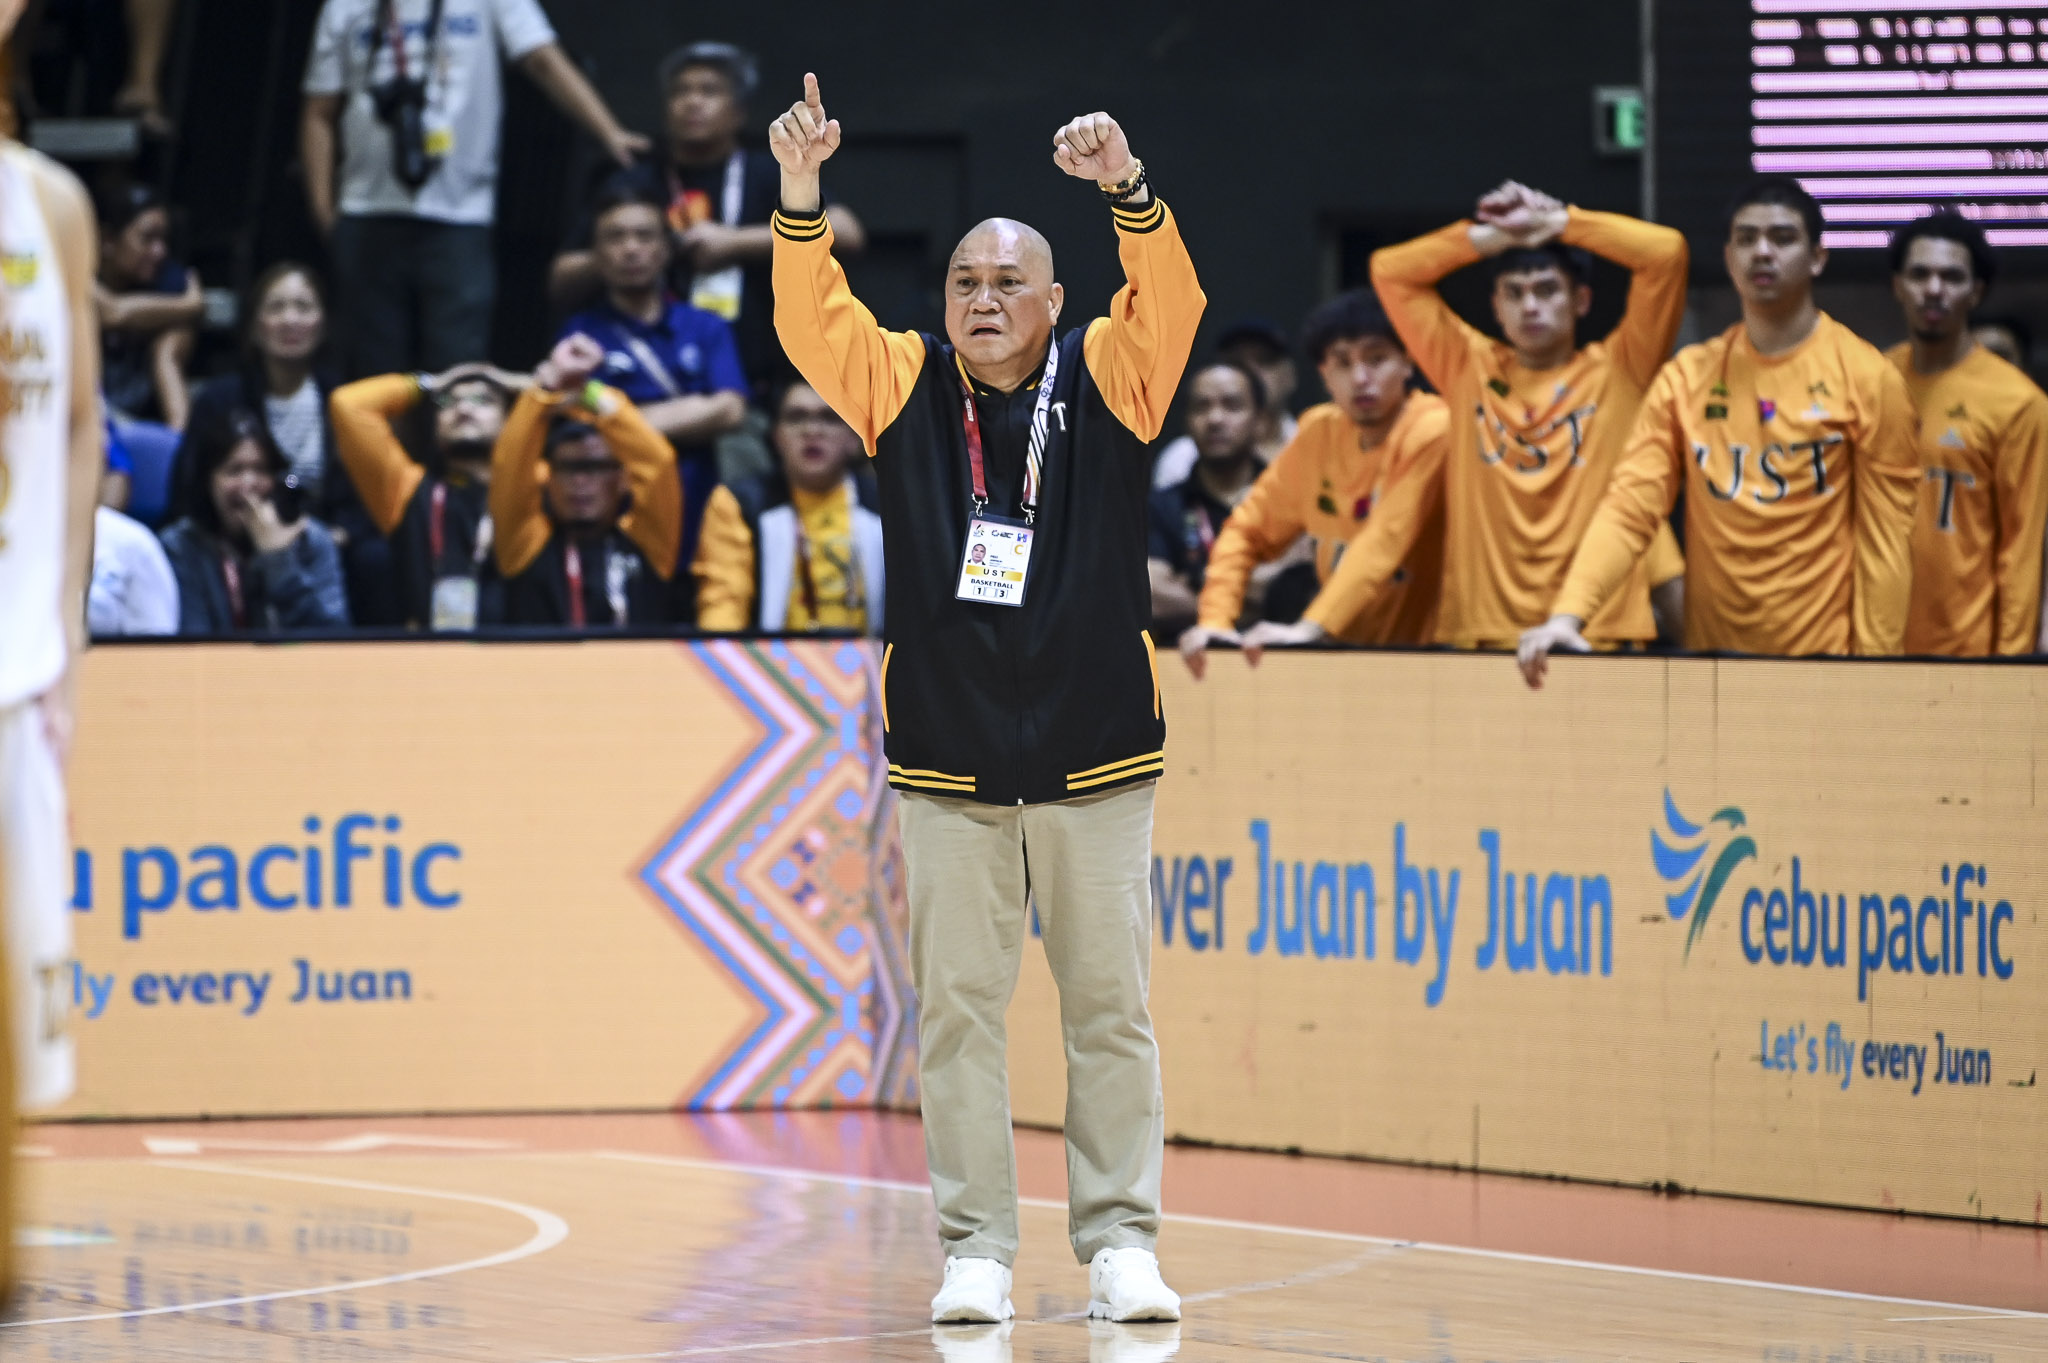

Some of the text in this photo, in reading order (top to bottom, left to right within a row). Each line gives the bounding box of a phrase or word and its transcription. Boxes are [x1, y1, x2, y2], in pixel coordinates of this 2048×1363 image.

[1476, 404, 1597, 475] UST
[1692, 431, 1844, 505] UST
[970, 578, 1014, 589] BASKETBALL
[121, 813, 463, 940] pacific
[1152, 818, 1612, 1007] ver Juan by Juan
[1740, 855, 2014, 1003] cebu pacific
[73, 957, 412, 1019] ly every Juan
[1760, 1019, 1991, 1096] Let's fly every Juan
